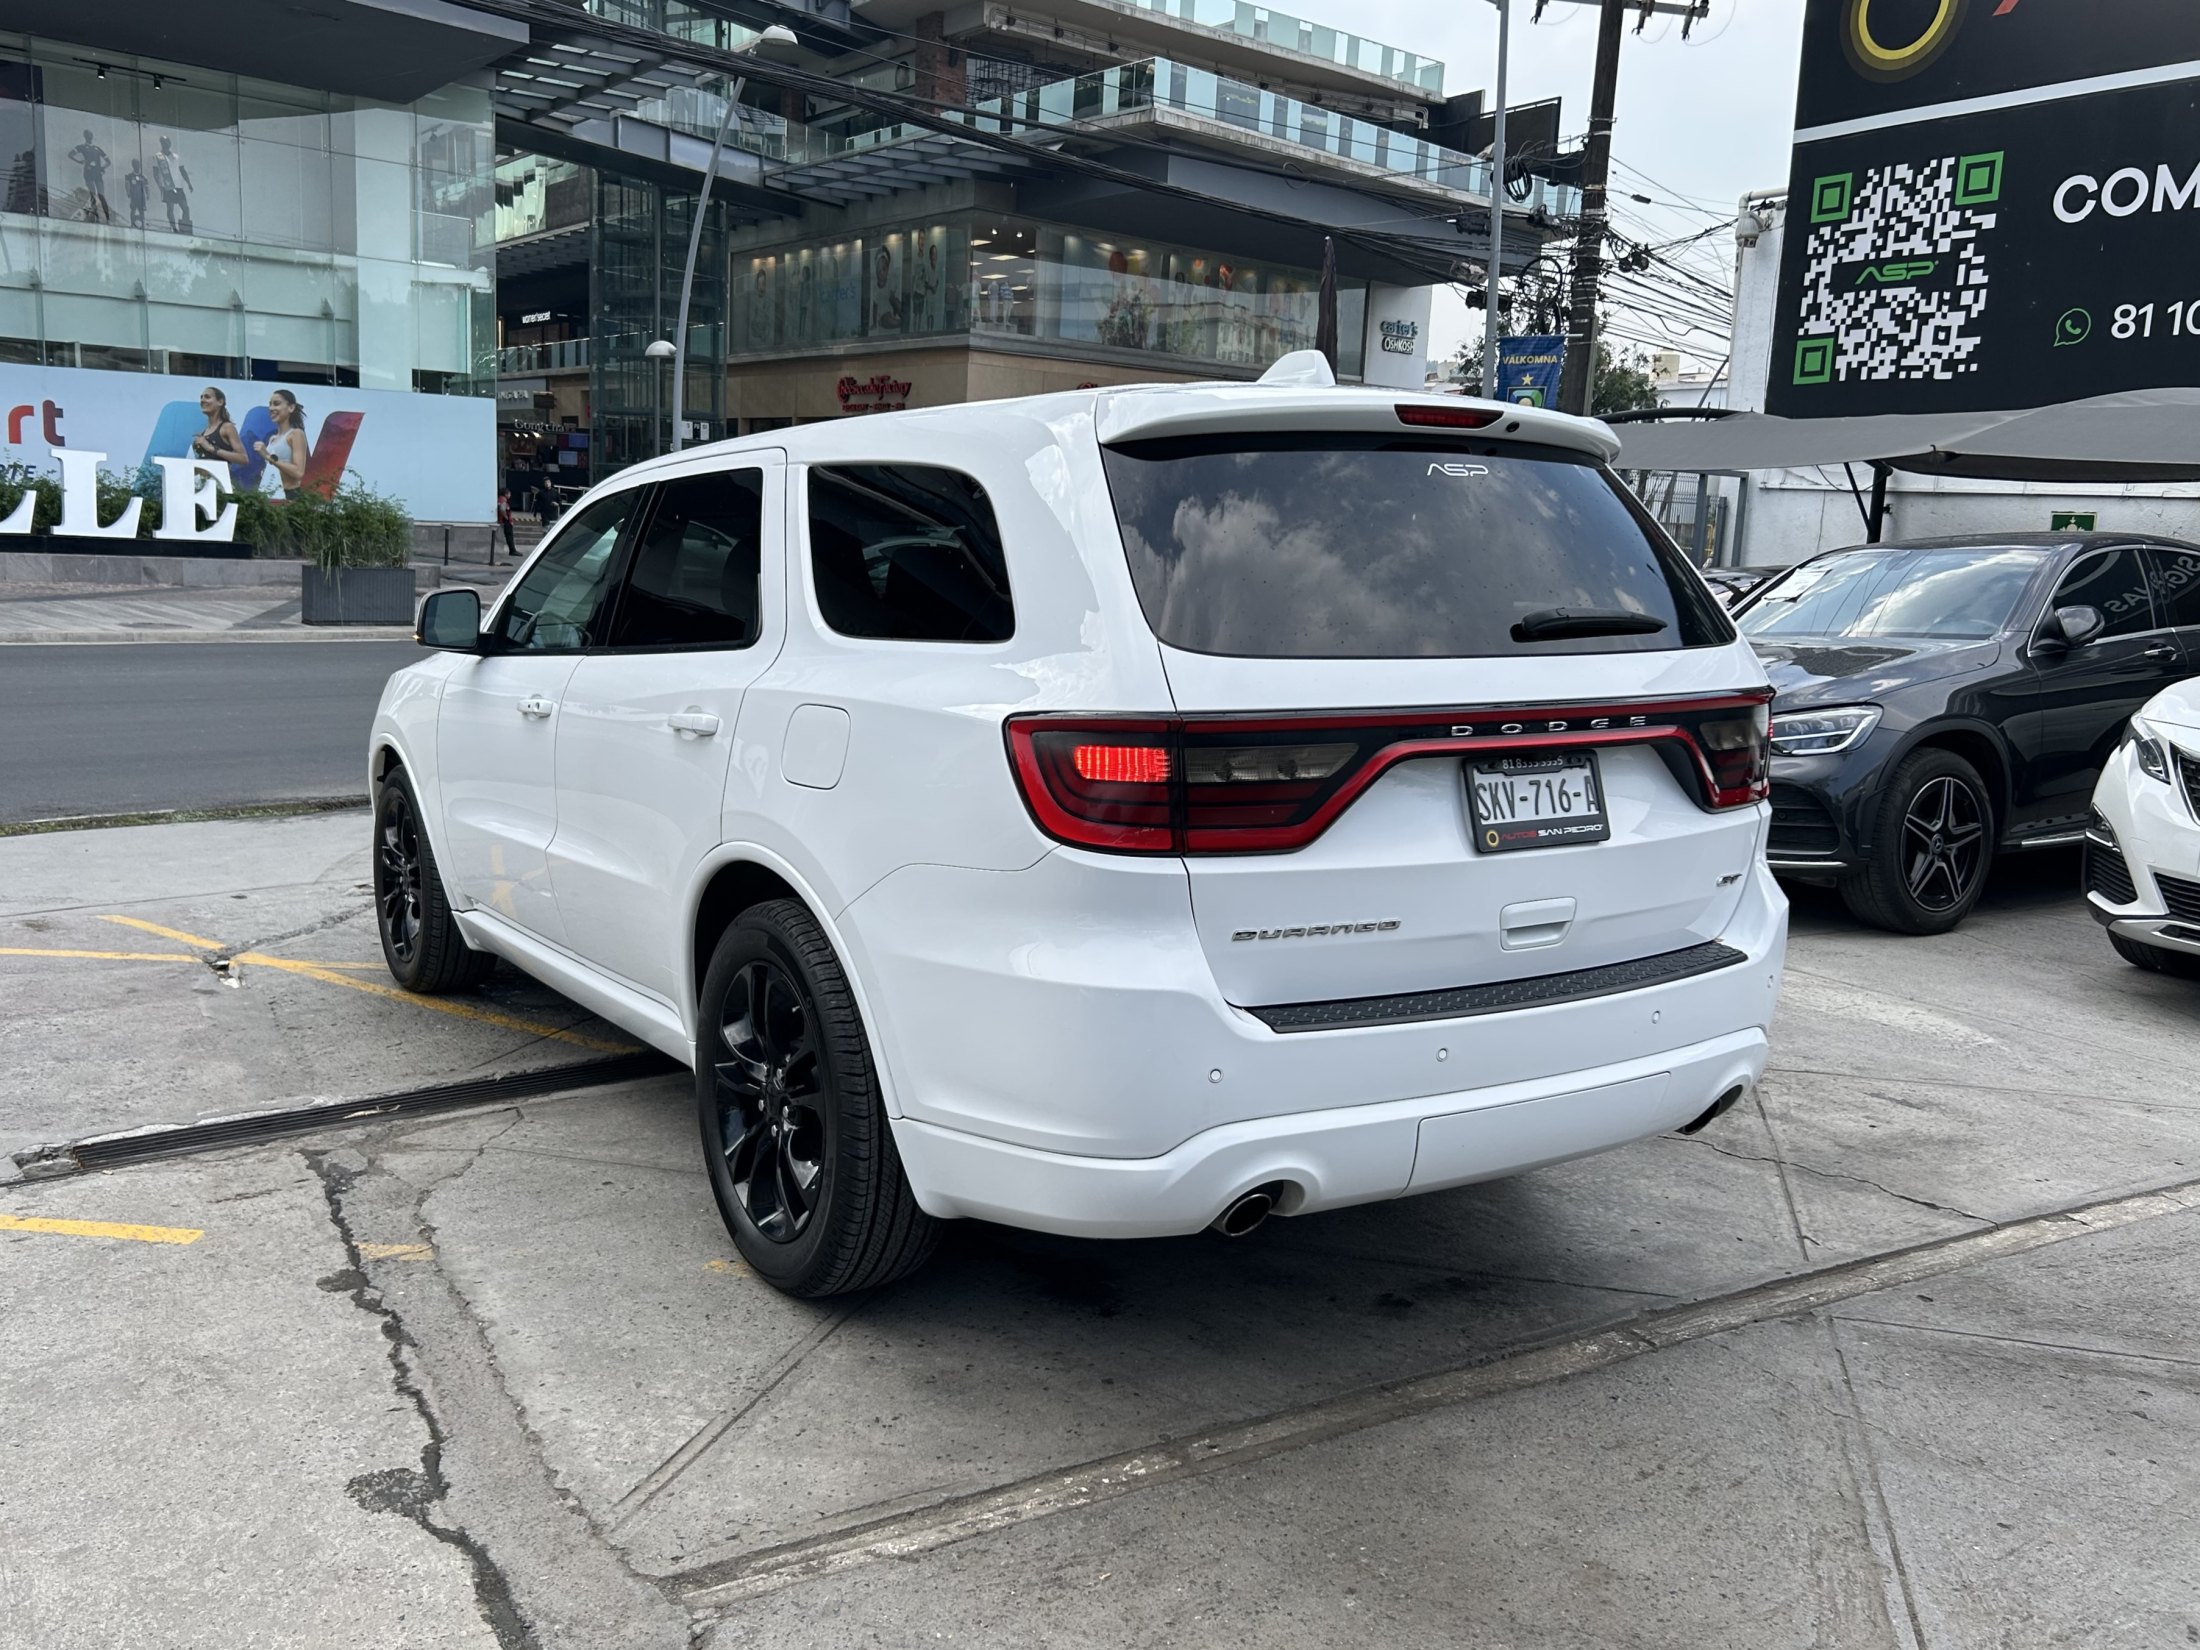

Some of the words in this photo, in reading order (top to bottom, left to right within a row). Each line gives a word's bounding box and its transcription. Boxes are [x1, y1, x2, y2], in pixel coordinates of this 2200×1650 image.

[1855, 260, 1936, 285] ASP
[2111, 303, 2154, 339] 81
[1451, 716, 1647, 737] DODGE
[1476, 775, 1600, 821] SKV-716-A
[1538, 827, 1562, 837] SAN
[1564, 823, 1602, 834] PEDRO
[1232, 919, 1401, 941] DURANGO
